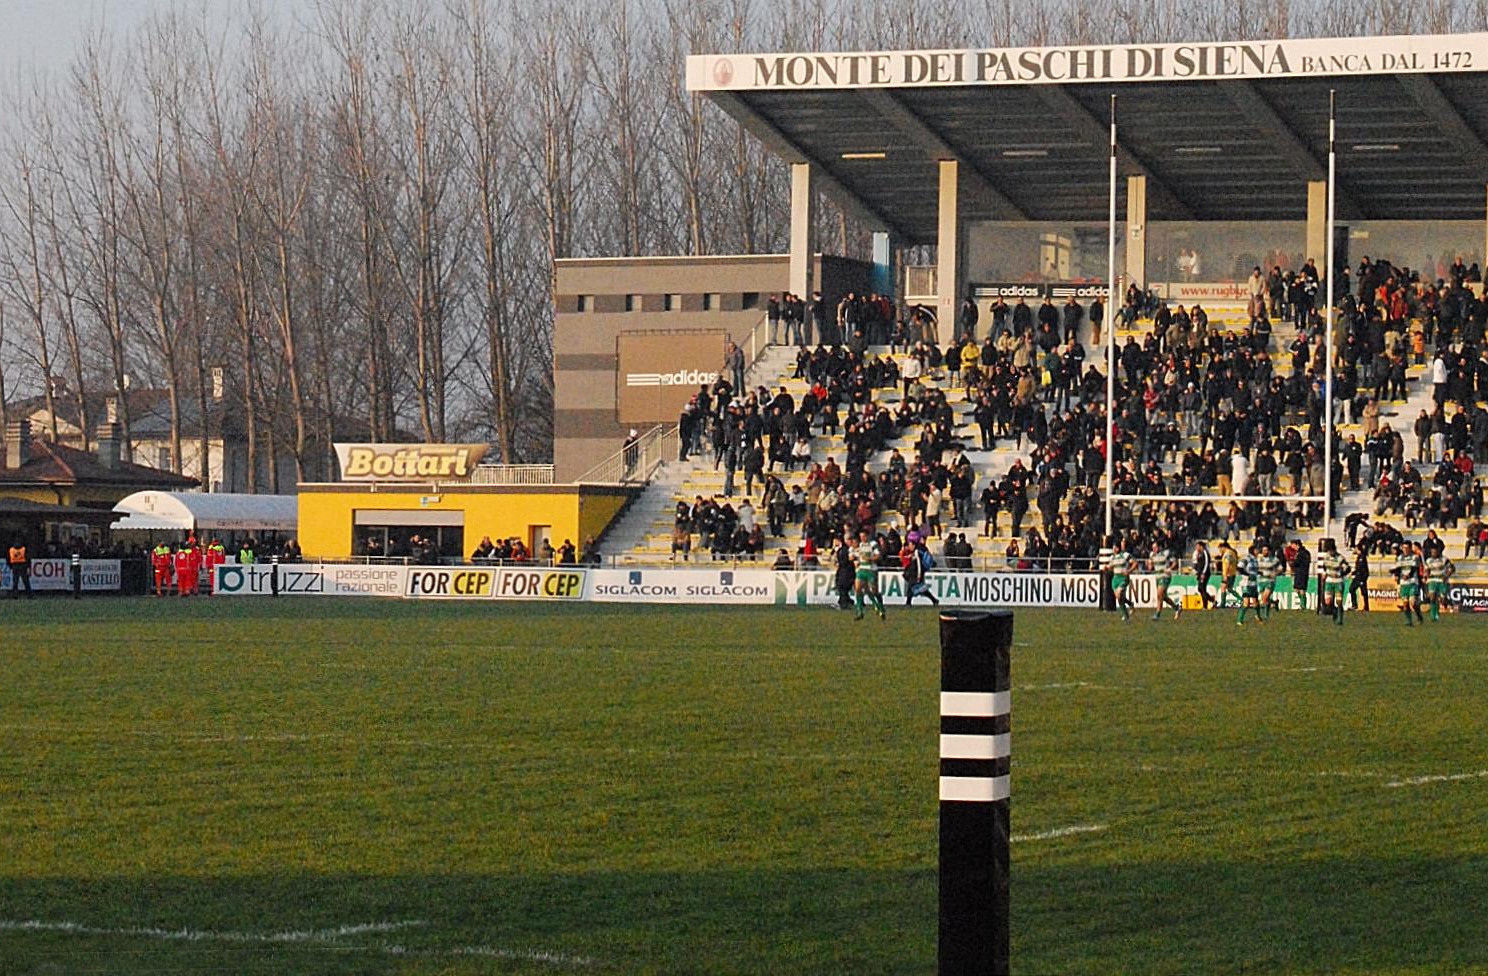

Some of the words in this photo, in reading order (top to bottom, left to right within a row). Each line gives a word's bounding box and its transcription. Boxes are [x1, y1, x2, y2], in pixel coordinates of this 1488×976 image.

[752, 55, 893, 87] MONTE
[902, 52, 966, 84] DEI
[975, 49, 1113, 83] PASCHI
[1126, 47, 1164, 79] DI
[1173, 44, 1293, 77] SIENA
[1301, 54, 1373, 73] BANCA
[1381, 52, 1425, 71] DAL
[1433, 51, 1473, 69] 1472
[999, 285, 1039, 297] adidas
[1077, 285, 1111, 297] adida
[661, 369, 718, 386] adidas
[346, 446, 469, 477] Bottari
[32, 561, 66, 578] COH
[334, 568, 399, 583] passione
[247, 565, 325, 593] truzzi
[409, 572, 450, 595] FOR
[453, 571, 490, 595] CEP
[501, 573, 542, 596] FOR
[544, 573, 581, 596] CEP
[594, 584, 677, 596] SIGLACOM
[685, 585, 769, 597] SIGLACOM
[963, 576, 1053, 603] MOSCHINO
[1060, 577, 1151, 604] MOSNO
